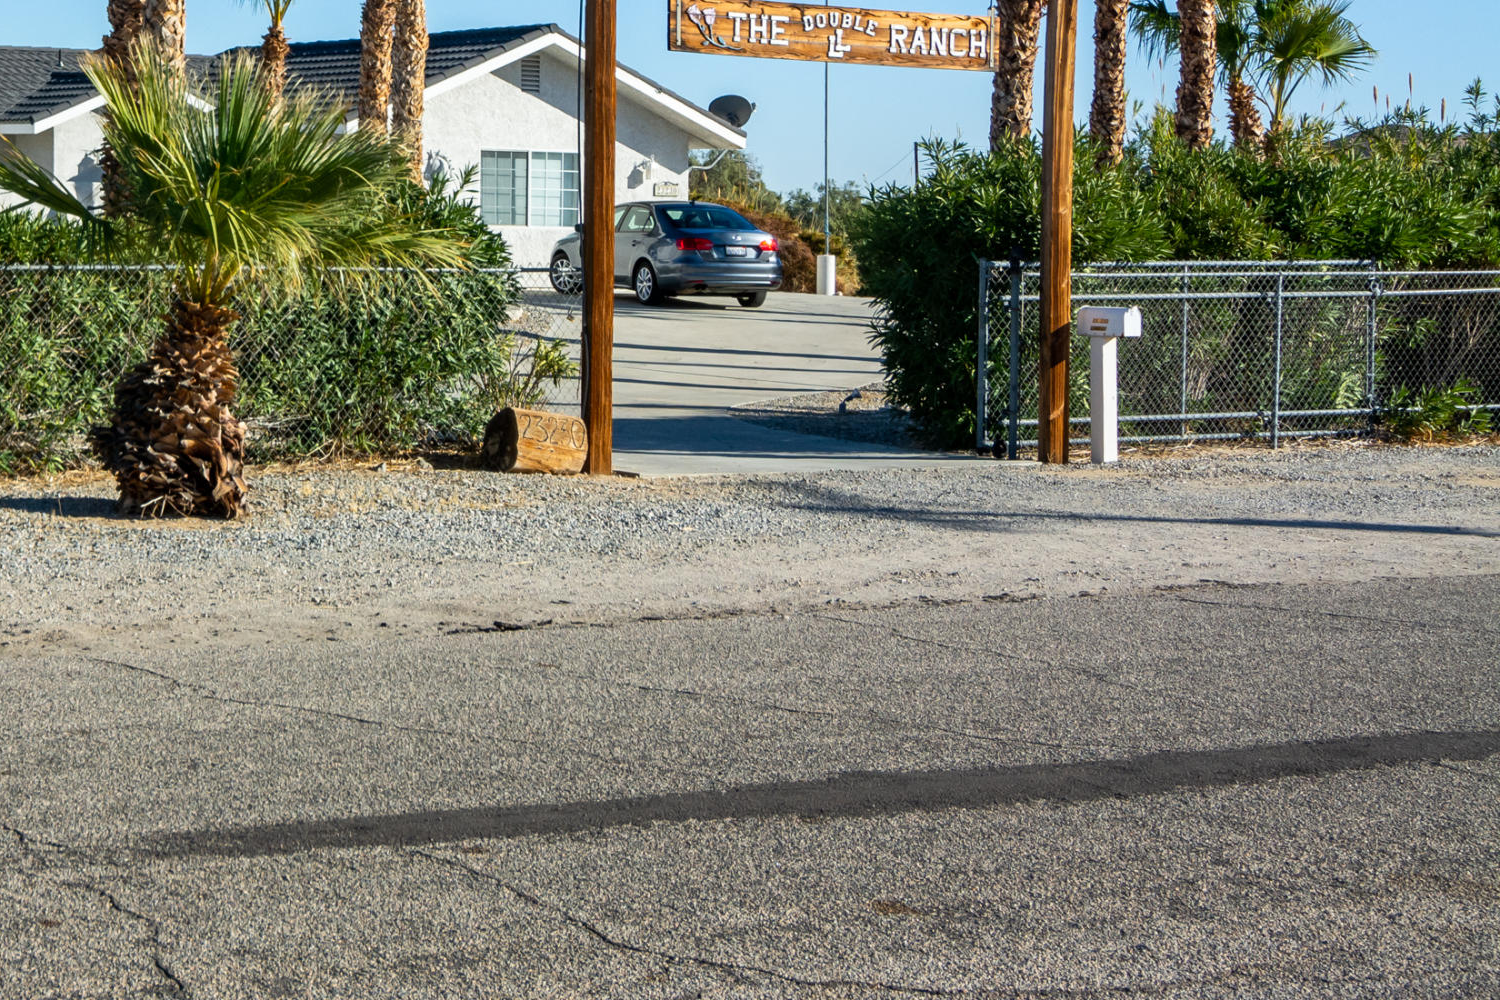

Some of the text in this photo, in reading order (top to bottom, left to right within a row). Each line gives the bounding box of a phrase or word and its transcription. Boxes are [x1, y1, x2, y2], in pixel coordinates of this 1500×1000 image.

[727, 11, 790, 46] THE
[802, 11, 879, 37] DOUBLE
[888, 24, 988, 59] RANCH
